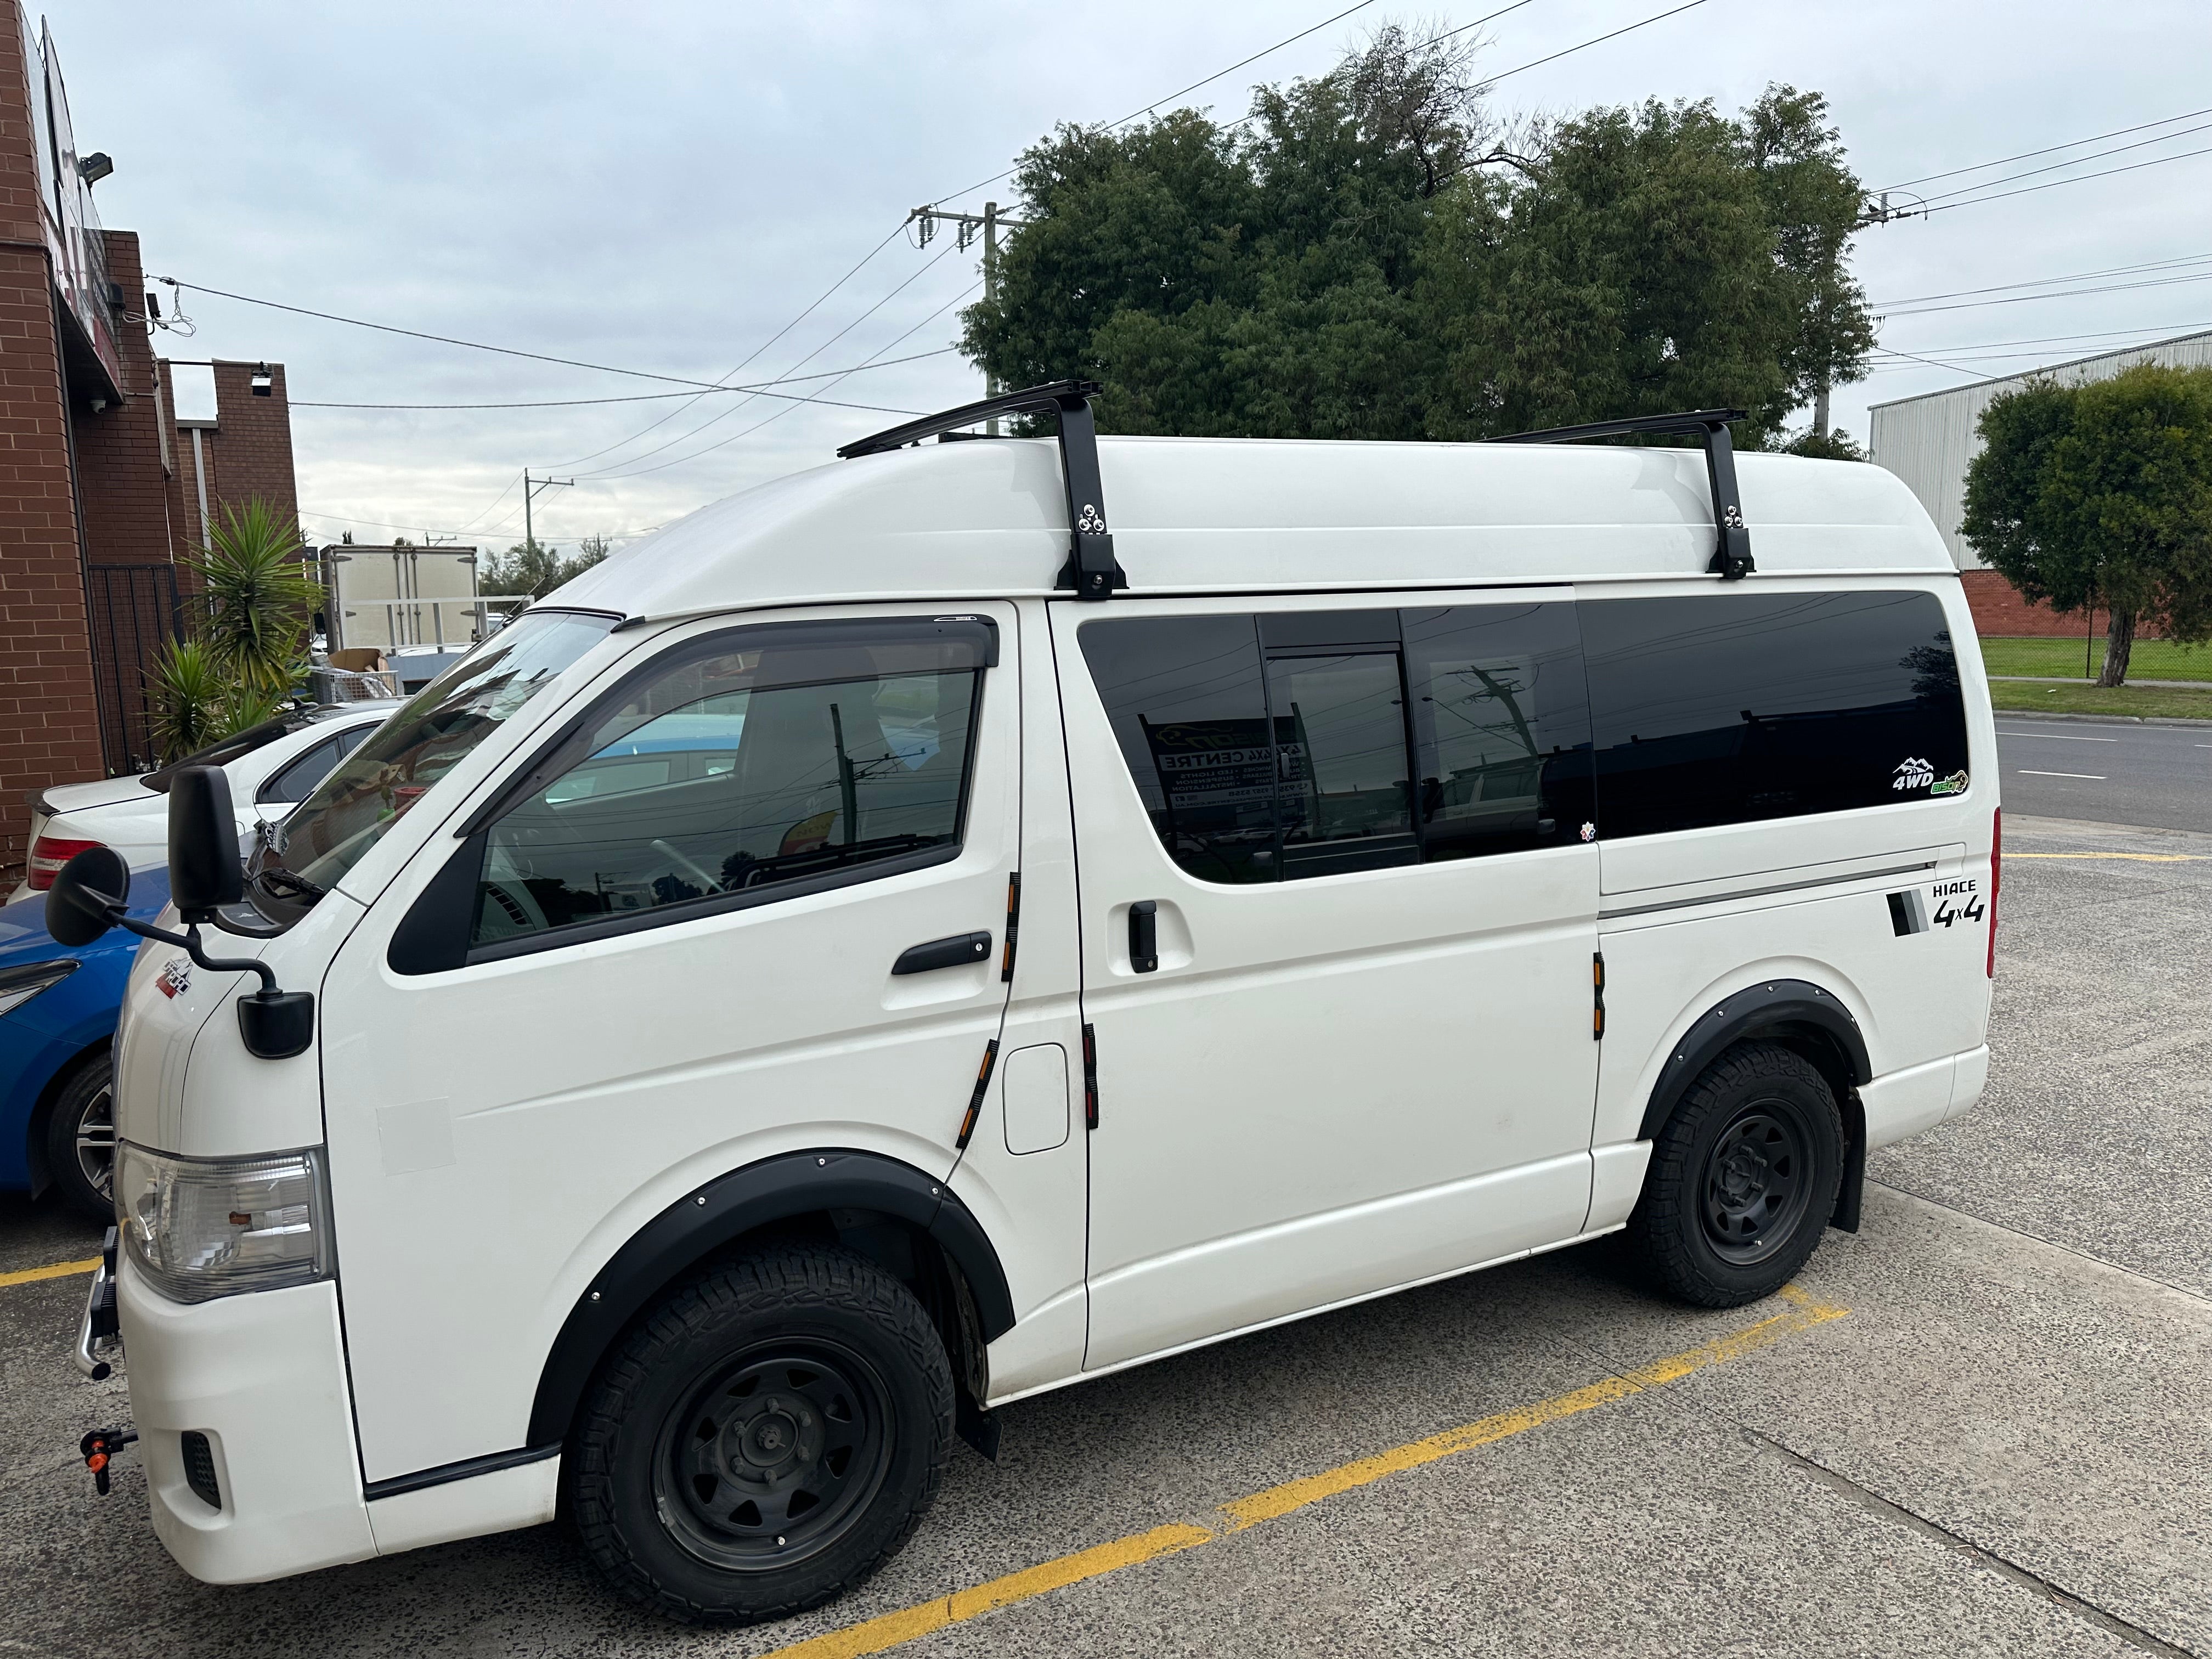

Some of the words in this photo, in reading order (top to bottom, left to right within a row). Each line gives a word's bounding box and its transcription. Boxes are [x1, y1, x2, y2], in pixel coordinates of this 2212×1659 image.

[1893, 772, 1934, 791] 4WD
[1933, 879, 1976, 898] HIACE
[168, 973, 191, 995] ROAD
